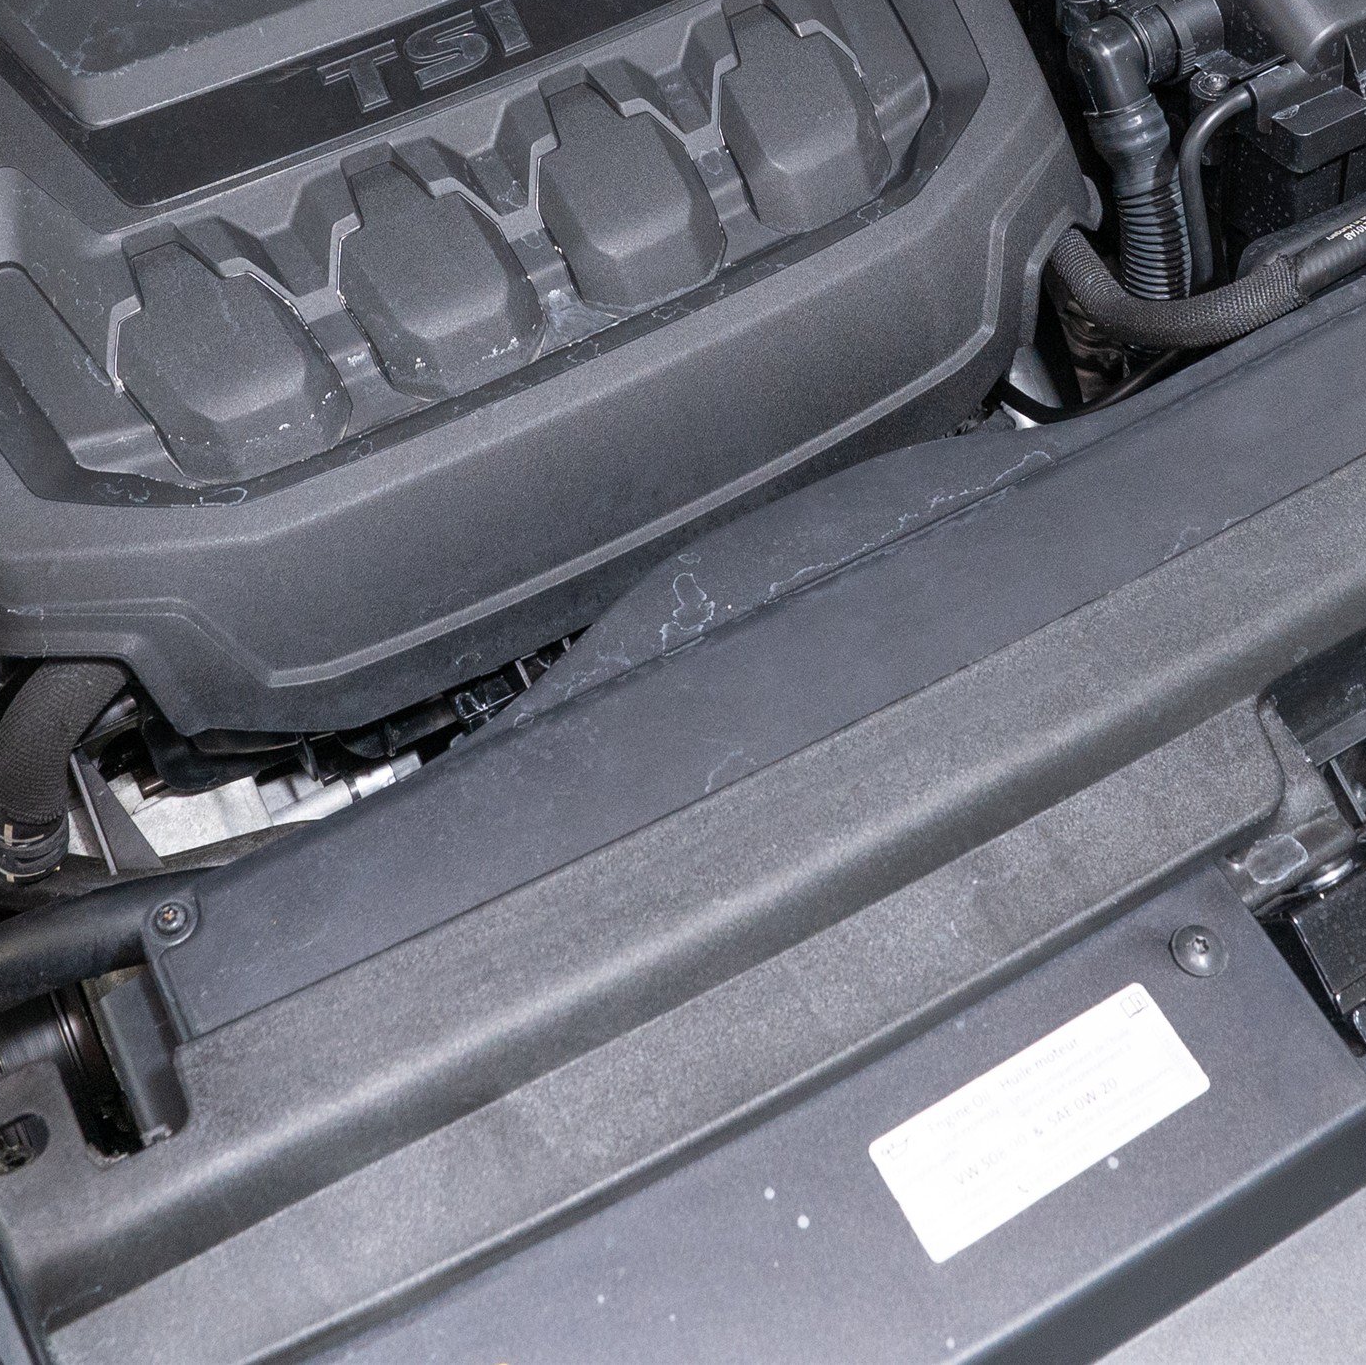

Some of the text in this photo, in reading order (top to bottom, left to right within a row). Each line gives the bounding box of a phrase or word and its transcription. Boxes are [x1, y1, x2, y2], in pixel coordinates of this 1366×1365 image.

[996, 1061, 1035, 1093] Huile
[1031, 1034, 1081, 1072] moteur
[951, 1160, 982, 1188] VW
[1029, 1122, 1046, 1139] &
[1044, 1102, 1074, 1129] SAE
